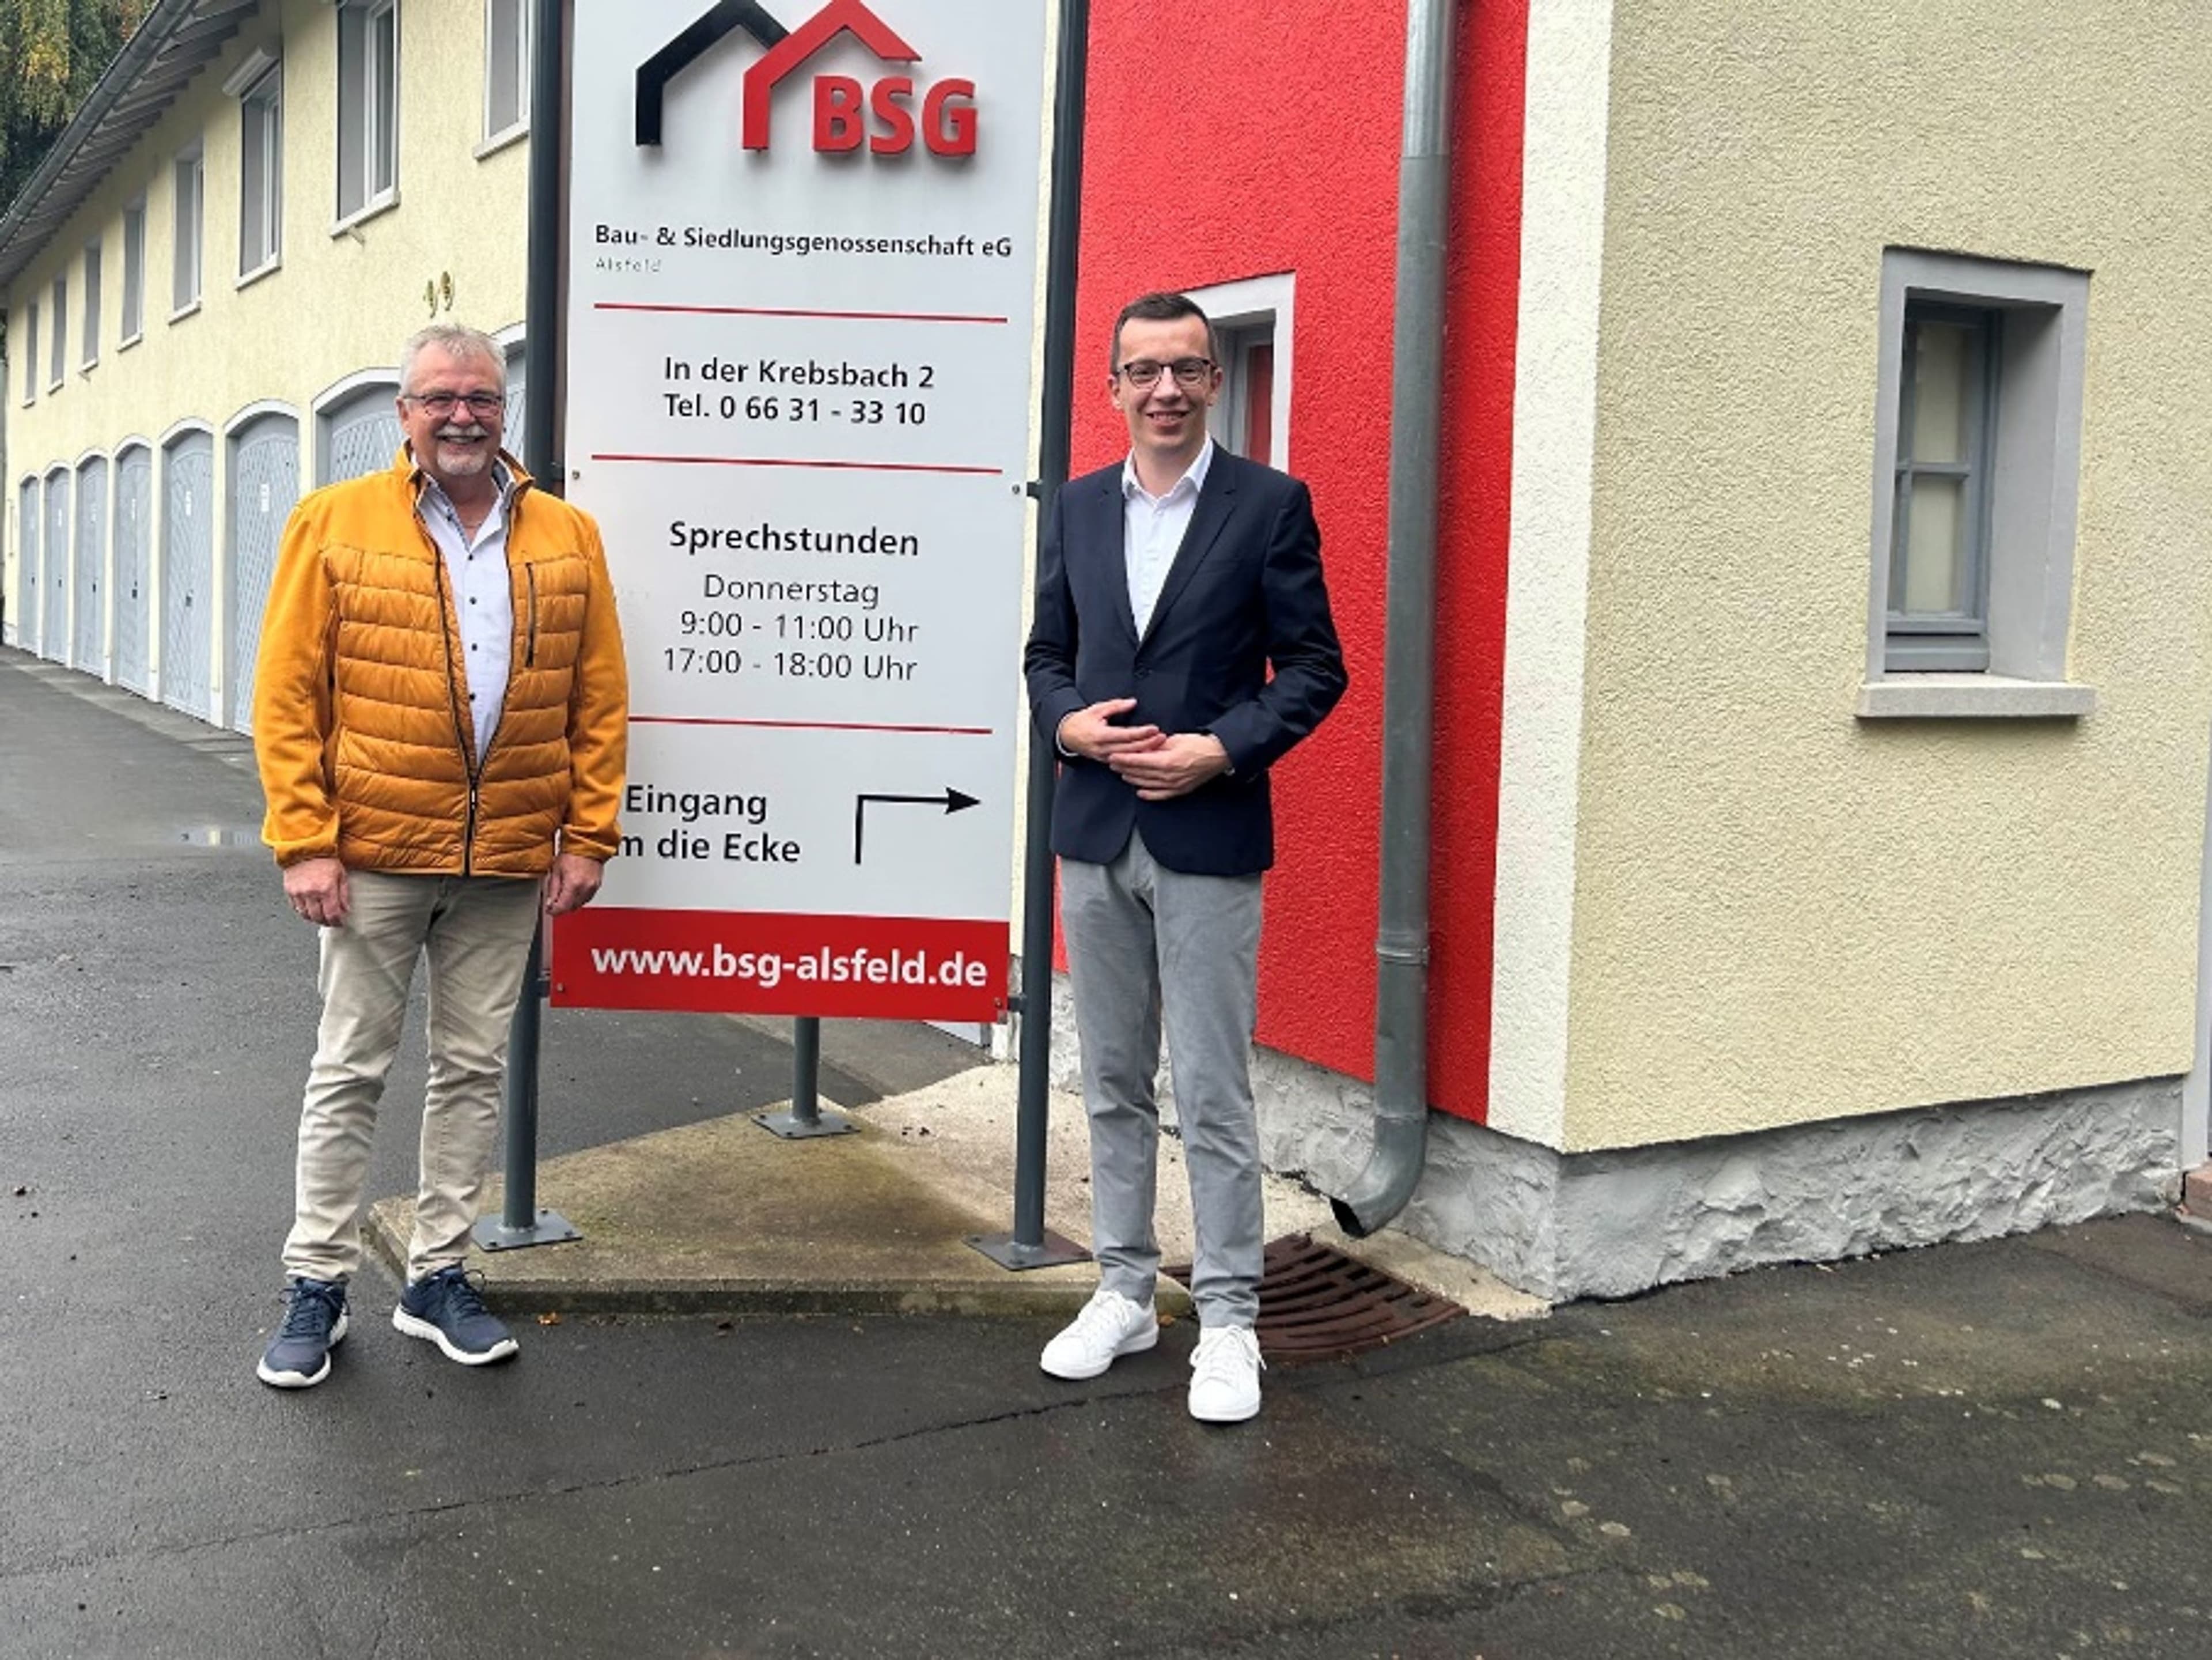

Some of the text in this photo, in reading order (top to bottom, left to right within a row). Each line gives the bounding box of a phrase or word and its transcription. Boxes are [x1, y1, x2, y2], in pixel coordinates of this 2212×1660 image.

[811, 74, 978, 156] BSG
[595, 224, 1012, 258] Bau- & Siedlungsgenossenschaft eG
[595, 257, 661, 273] Alsfeld
[665, 356, 934, 389] In der Krebsbach 2
[662, 392, 710, 418] Tel.
[719, 395, 736, 419] 0
[745, 395, 779, 421] 66
[789, 397, 818, 422] 31
[850, 399, 884, 425] 33
[895, 402, 926, 426] 10
[669, 520, 919, 557] Sprechstunden
[703, 573, 880, 610] Donnerstag
[681, 610, 743, 637] 9:00
[776, 614, 853, 642] 11:00
[864, 615, 919, 642] Uhr
[664, 647, 742, 674] 17:00
[774, 652, 853, 679] 18:00
[863, 654, 918, 681] Uhr
[624, 783, 767, 826] Eingang
[620, 827, 801, 864] m die Ecke
[591, 943, 987, 988] www.bsg-alsfeld.de
